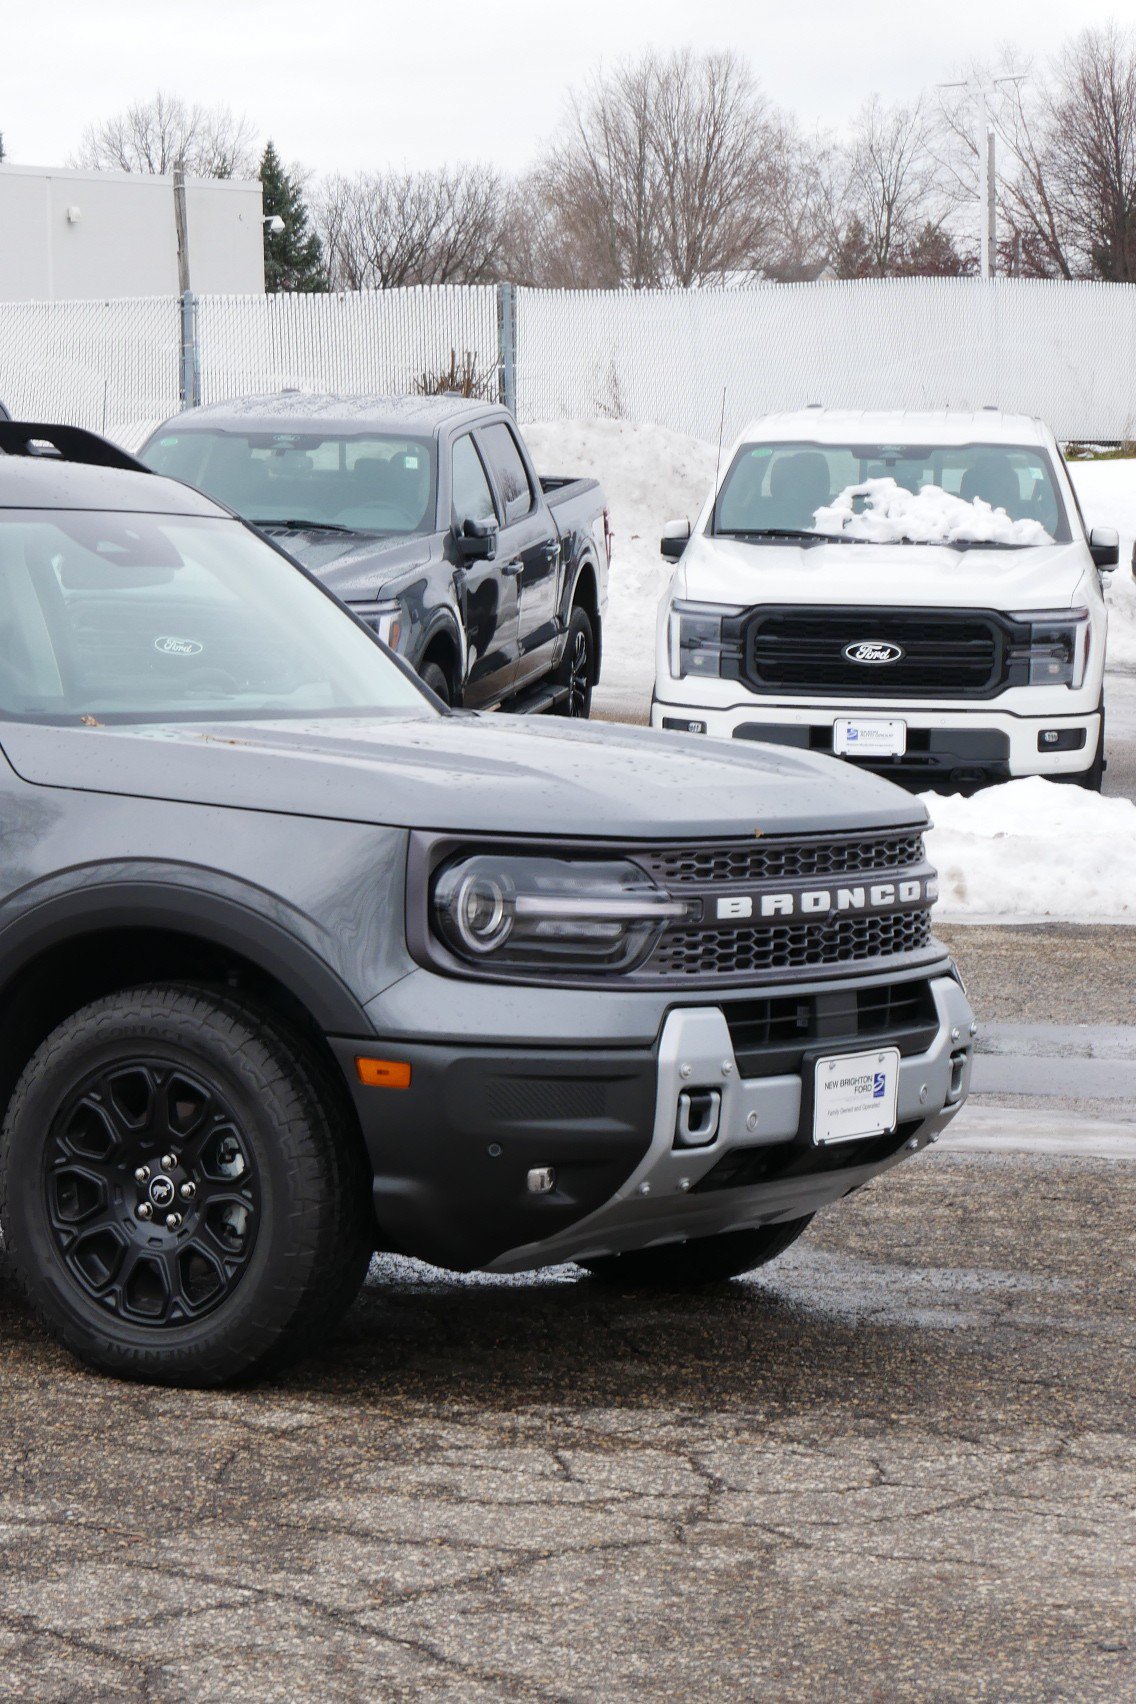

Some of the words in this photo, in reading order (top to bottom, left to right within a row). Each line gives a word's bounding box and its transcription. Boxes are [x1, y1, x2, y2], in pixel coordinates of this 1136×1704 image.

[163, 638, 192, 653] Ford
[855, 644, 890, 660] Ford
[717, 881, 921, 919] BRONCO
[824, 1080, 839, 1091] NEW
[839, 1075, 873, 1087] BRIGHTON
[854, 1084, 872, 1094] FORD
